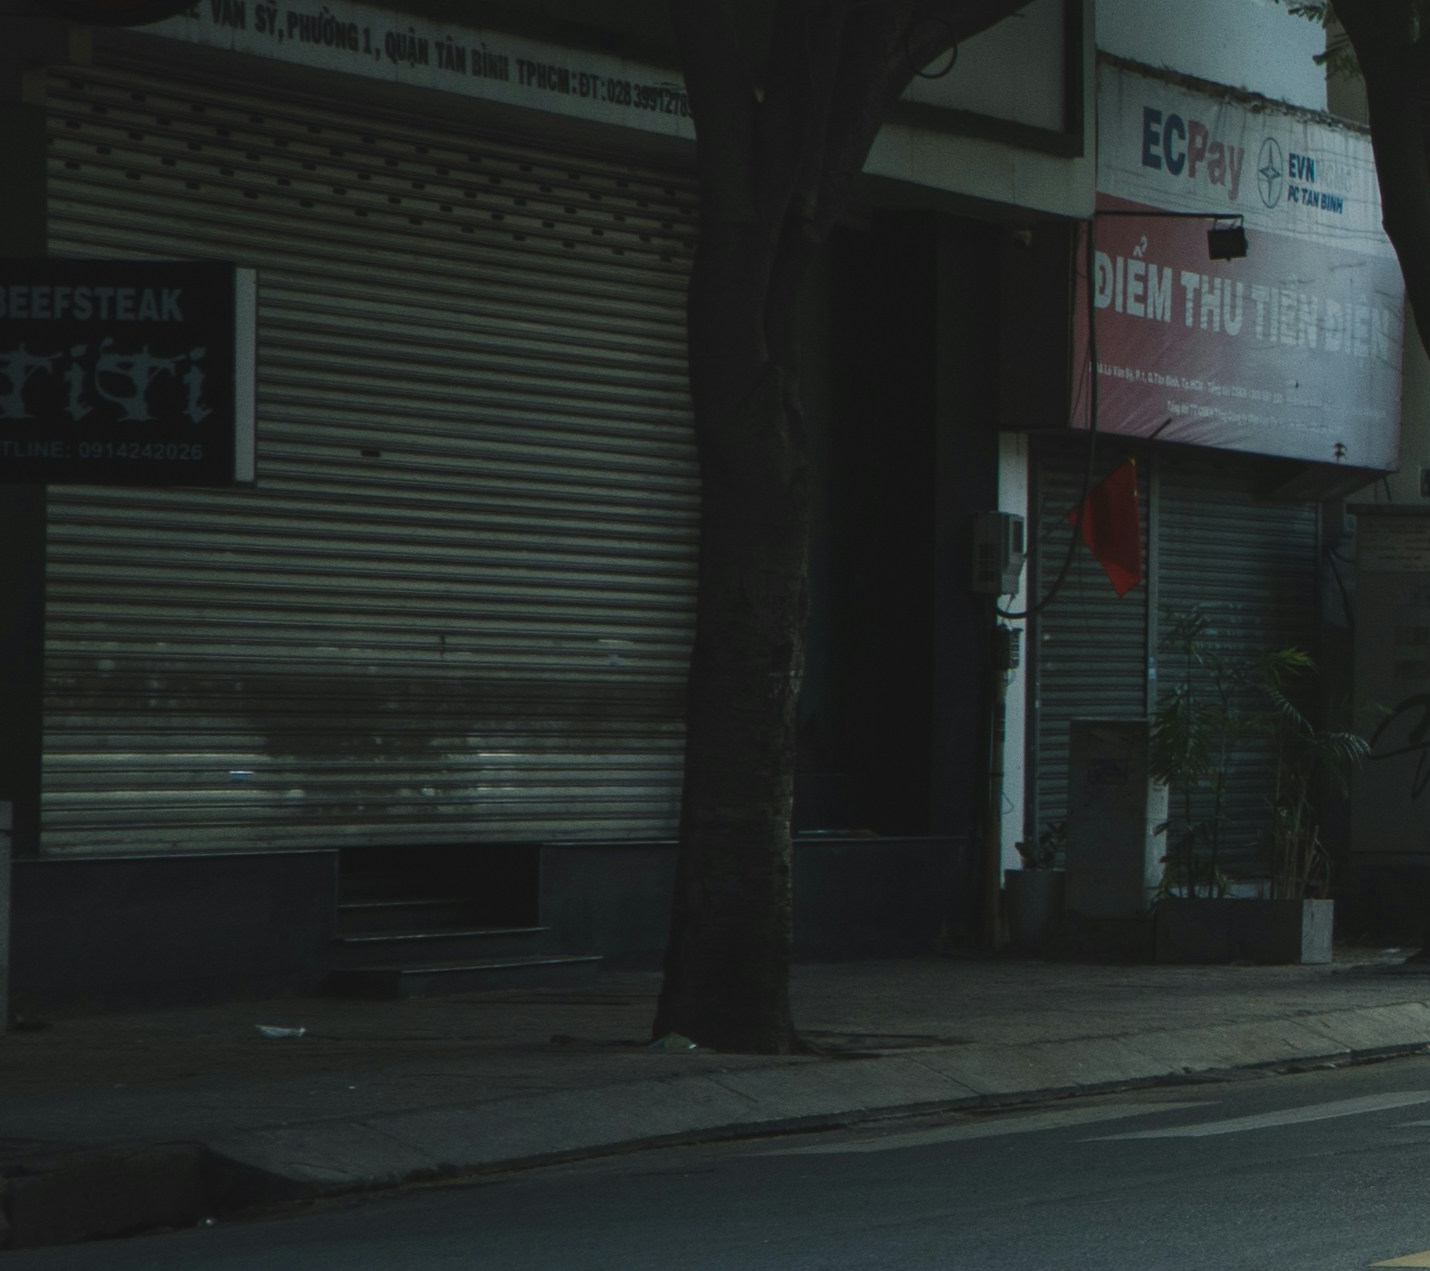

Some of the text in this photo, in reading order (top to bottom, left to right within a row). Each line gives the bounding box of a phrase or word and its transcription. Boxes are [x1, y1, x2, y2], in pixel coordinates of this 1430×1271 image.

[287, 6, 359, 51] PHƯỜNG
[385, 28, 429, 69] QUẬN
[435, 35, 467, 74] TÂN
[471, 42, 510, 82] BÌNH
[633, 84, 694, 120] 3991278
[1142, 105, 1245, 202] ECPay
[1093, 235, 1172, 323] ĐIỂM
[1180, 269, 1244, 337] THU
[0, 441, 204, 460] TLINE: 0914242026
